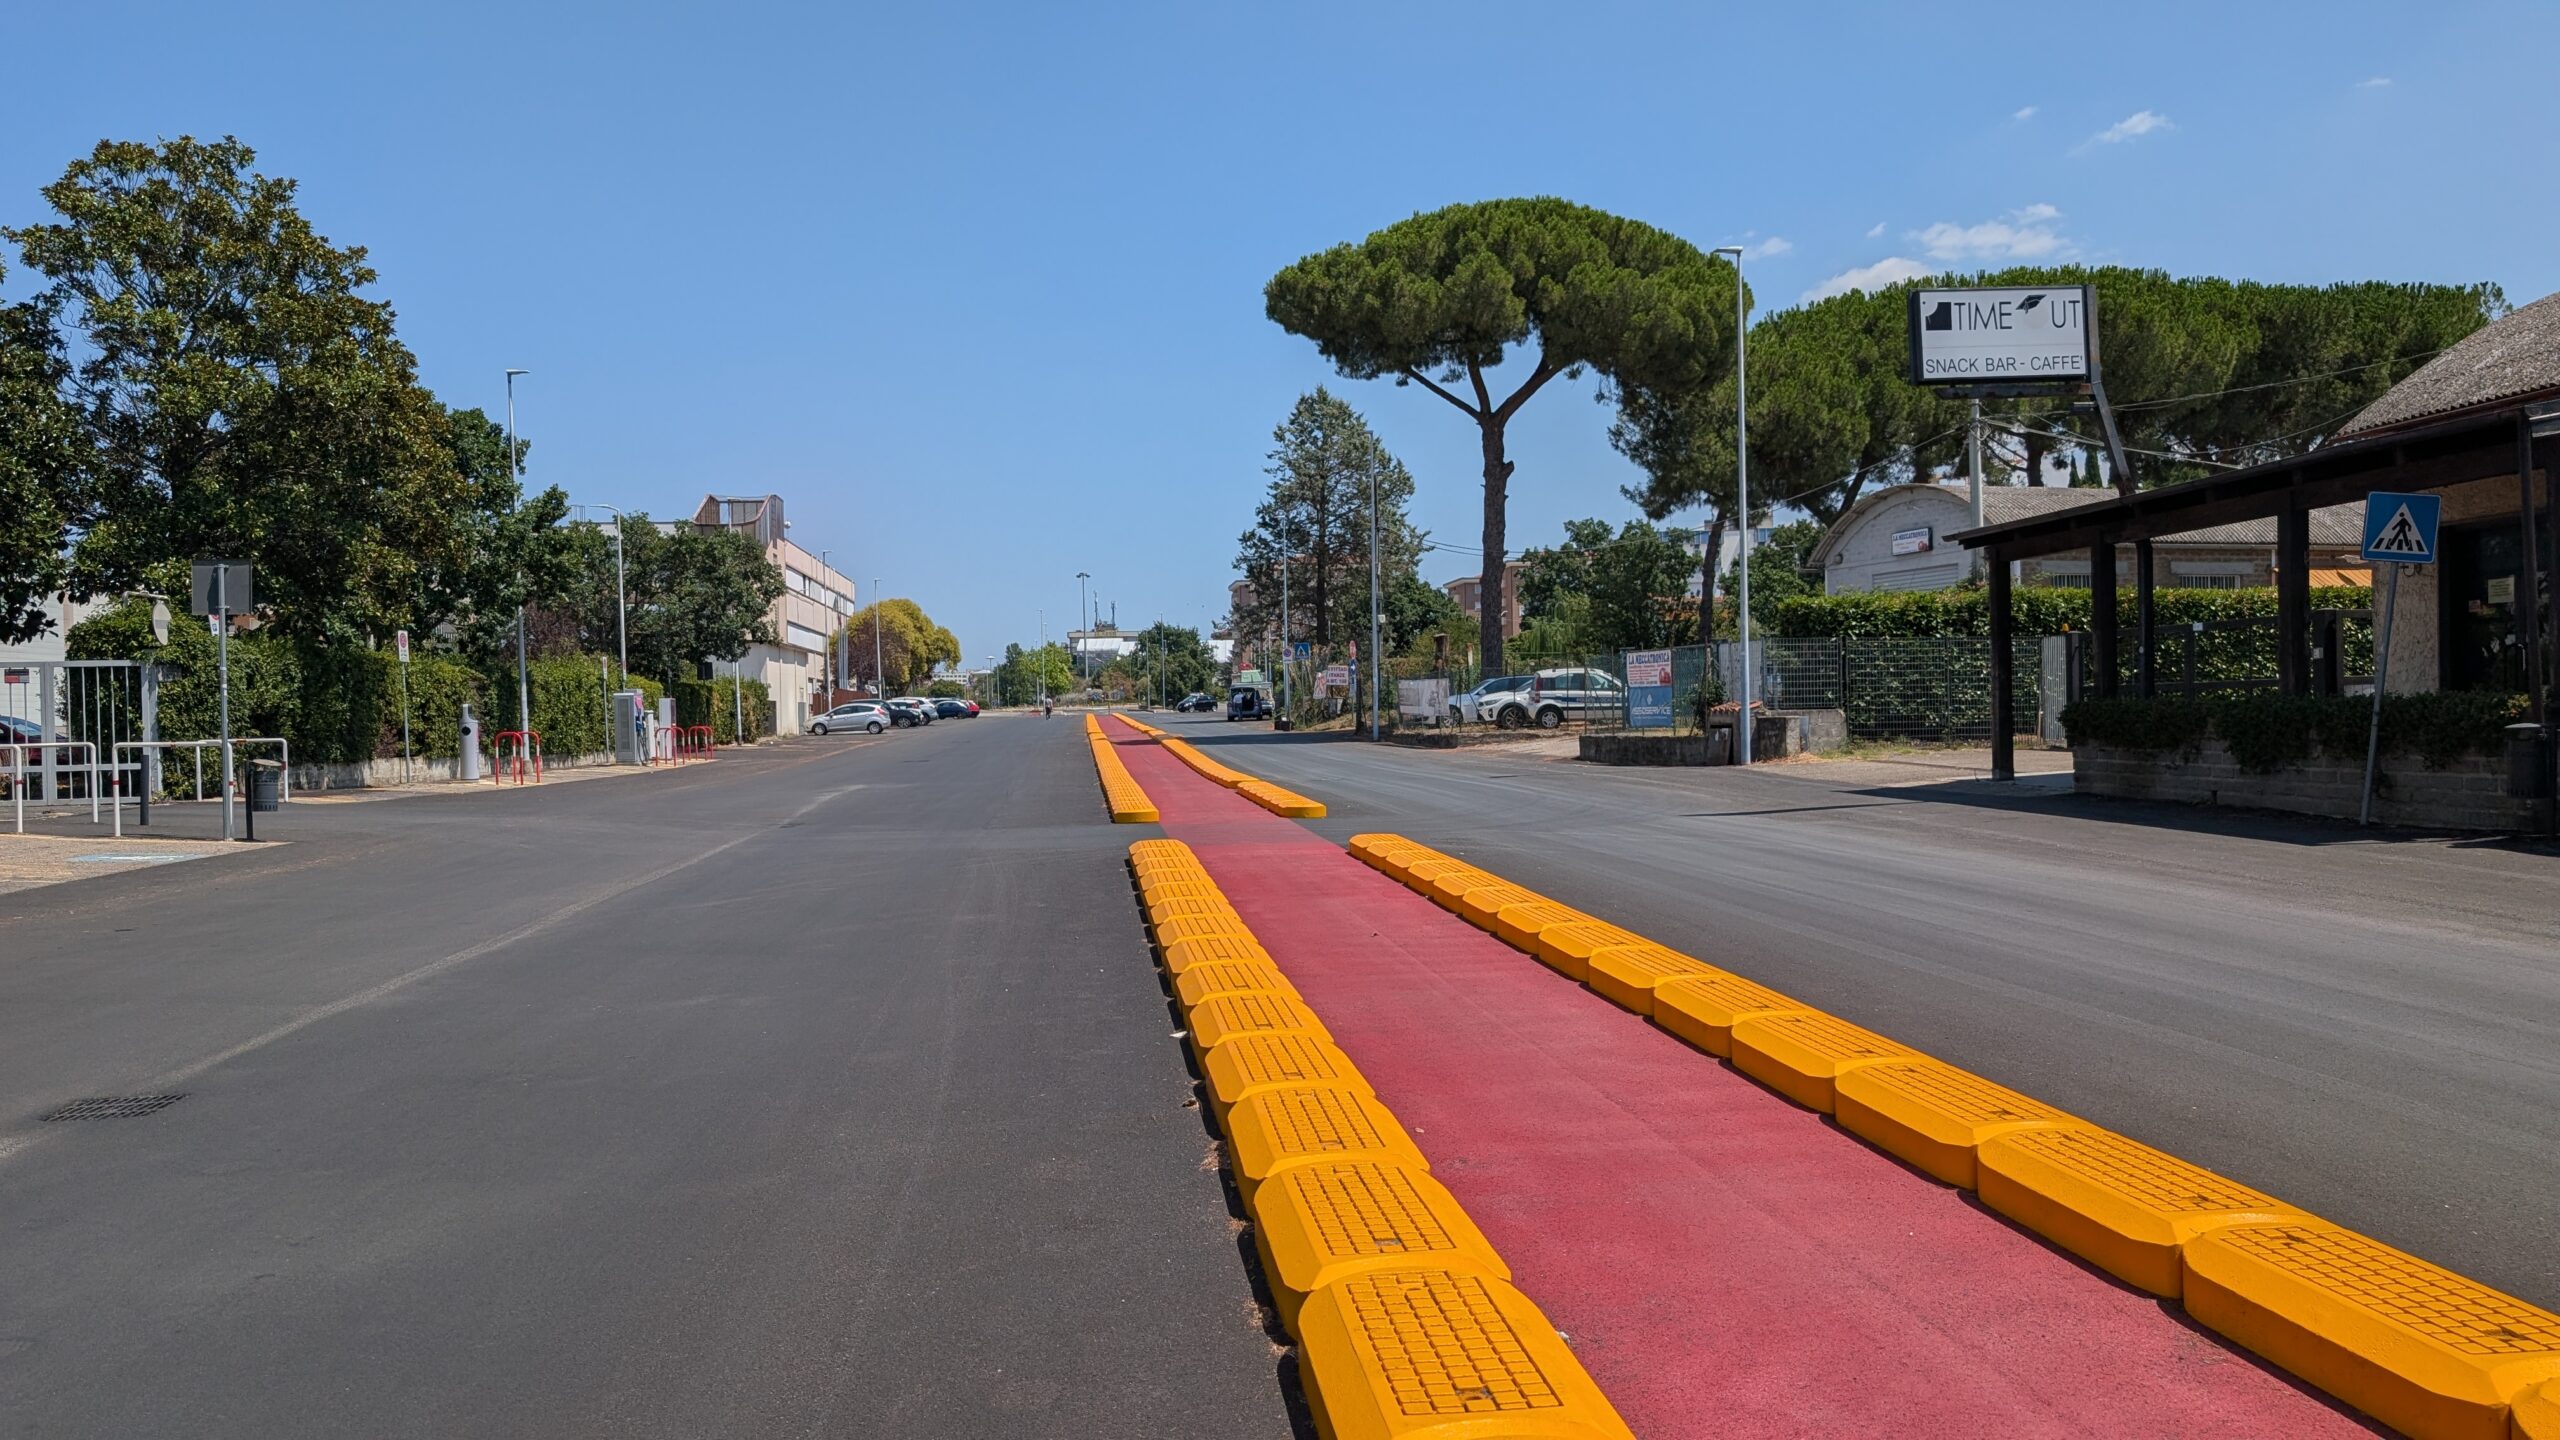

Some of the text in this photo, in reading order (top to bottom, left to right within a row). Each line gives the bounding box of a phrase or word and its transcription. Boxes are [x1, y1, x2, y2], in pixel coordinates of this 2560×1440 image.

[1954, 301, 2013, 331] TIME
[1925, 358, 1979, 374] SNACK
[1985, 357, 2017, 372] BAR
[2030, 355, 2083, 371] CAFFE'
